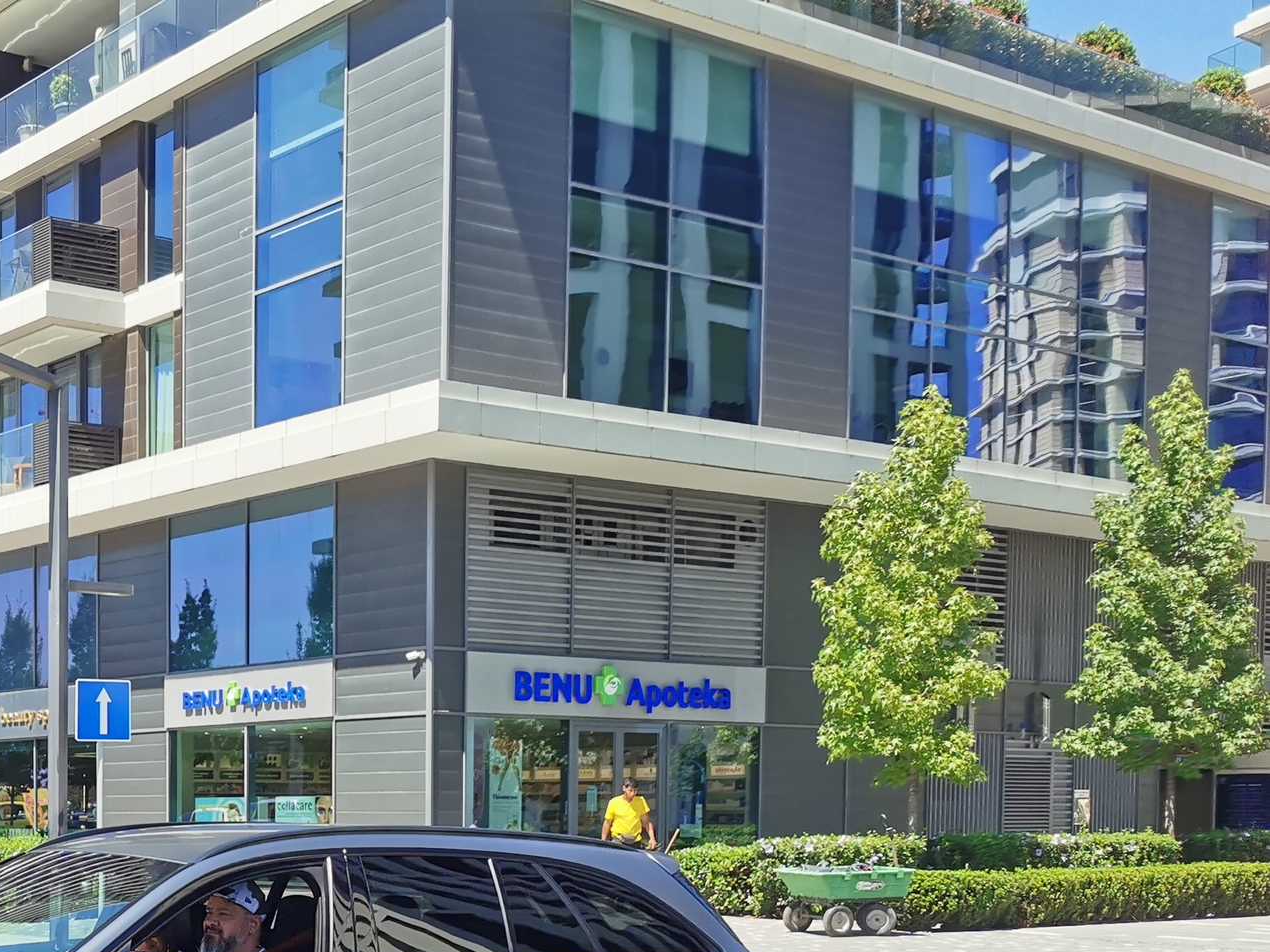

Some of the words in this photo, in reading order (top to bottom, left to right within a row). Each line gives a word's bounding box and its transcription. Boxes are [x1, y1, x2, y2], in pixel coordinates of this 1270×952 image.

[183, 689, 223, 709] BENU
[241, 681, 306, 708] Apoteka
[515, 671, 592, 704] BENU
[625, 678, 731, 713] Apoteka
[277, 800, 313, 810] collacare
